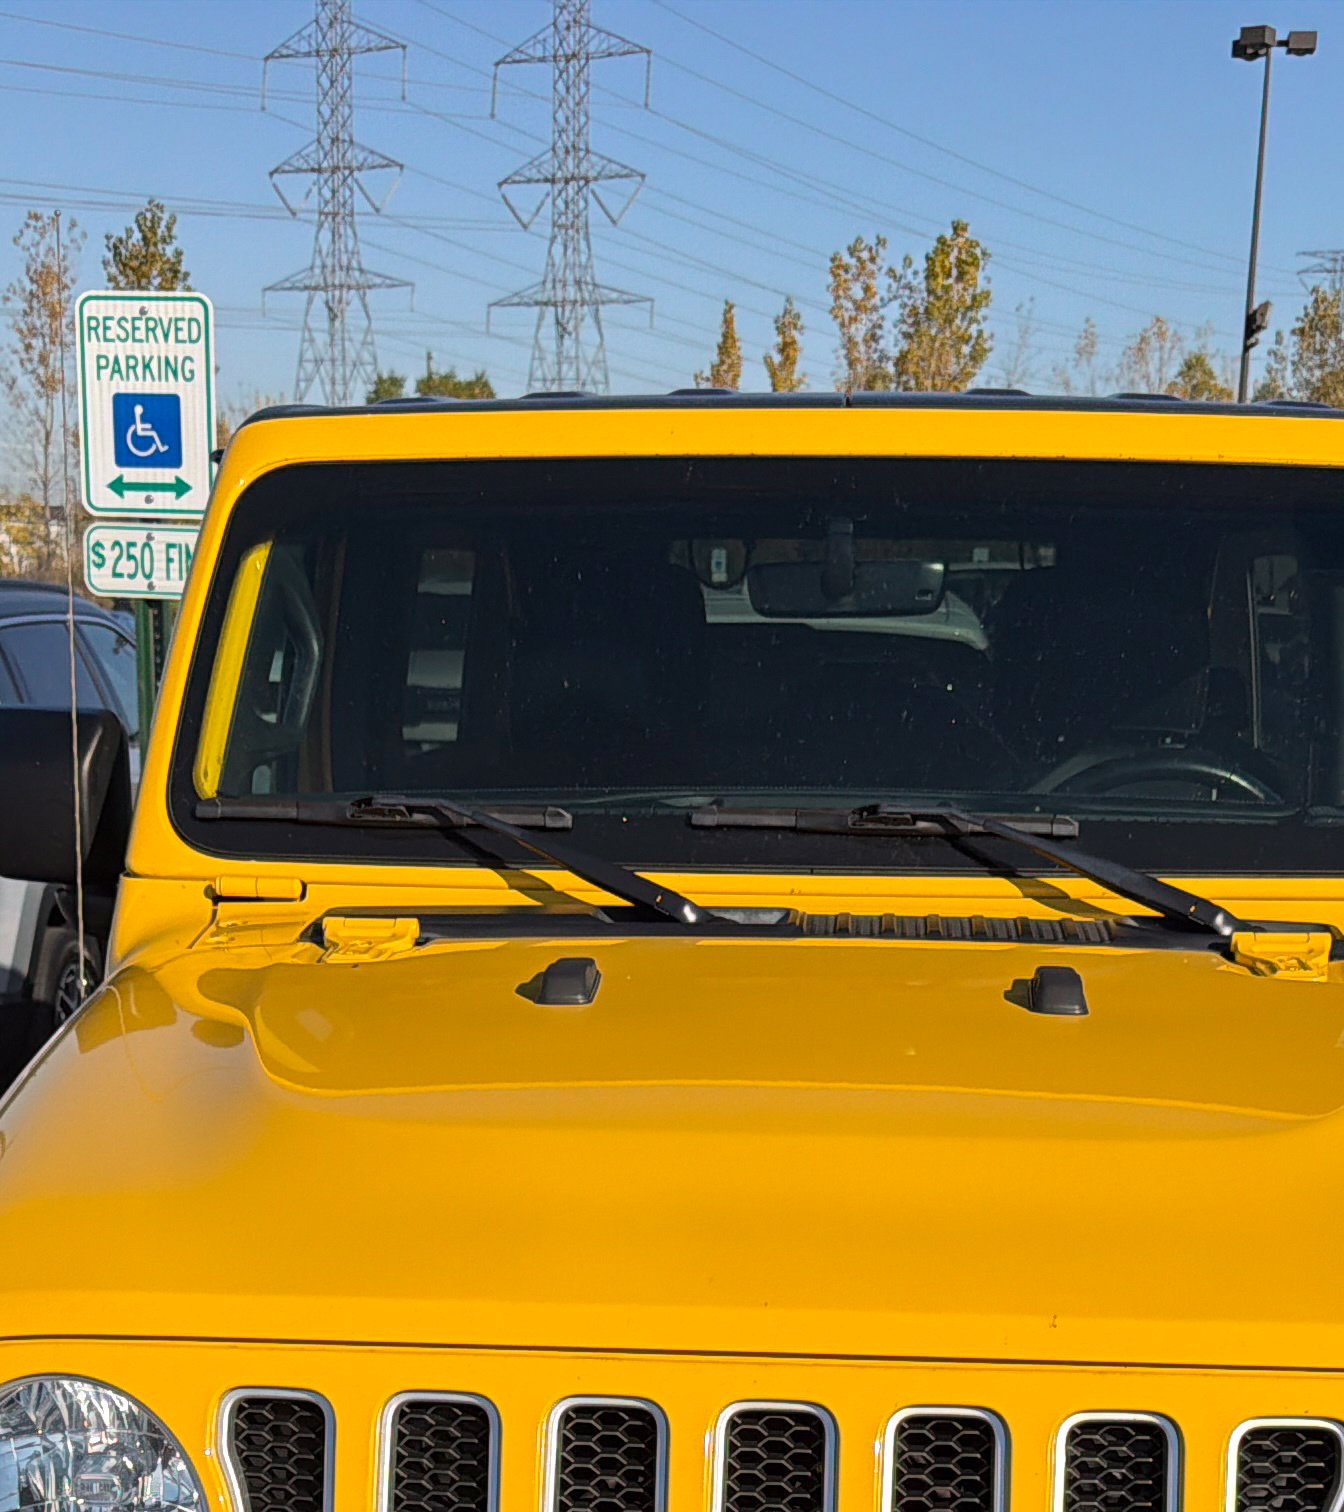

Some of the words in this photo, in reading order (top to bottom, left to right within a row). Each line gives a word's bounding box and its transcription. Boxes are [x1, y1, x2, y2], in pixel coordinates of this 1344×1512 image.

[87, 316, 202, 345] RESERVED
[96, 355, 196, 383] PARKING
[91, 540, 154, 581] $250
